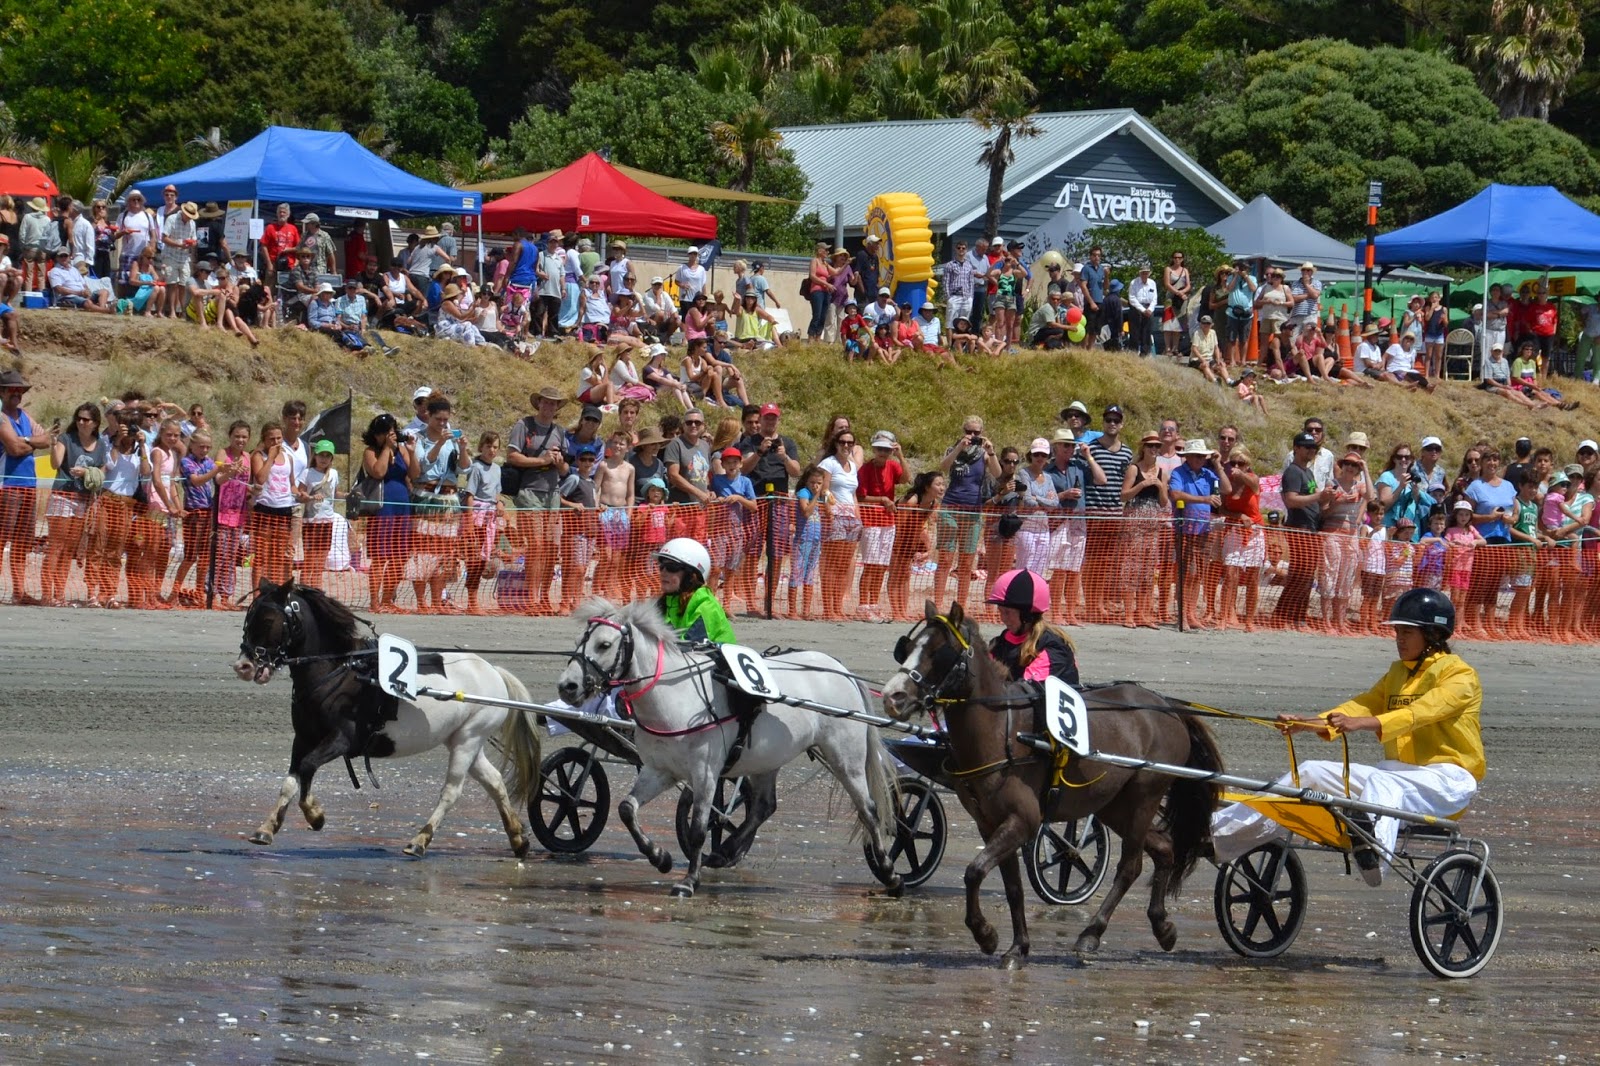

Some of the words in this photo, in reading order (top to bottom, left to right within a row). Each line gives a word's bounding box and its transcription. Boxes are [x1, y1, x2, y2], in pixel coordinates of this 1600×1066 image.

[1054, 182, 1079, 208] 4th
[1079, 183, 1177, 225] Avenue
[389, 646, 409, 690] 2
[737, 653, 765, 688] 6
[1058, 690, 1078, 738] 5
